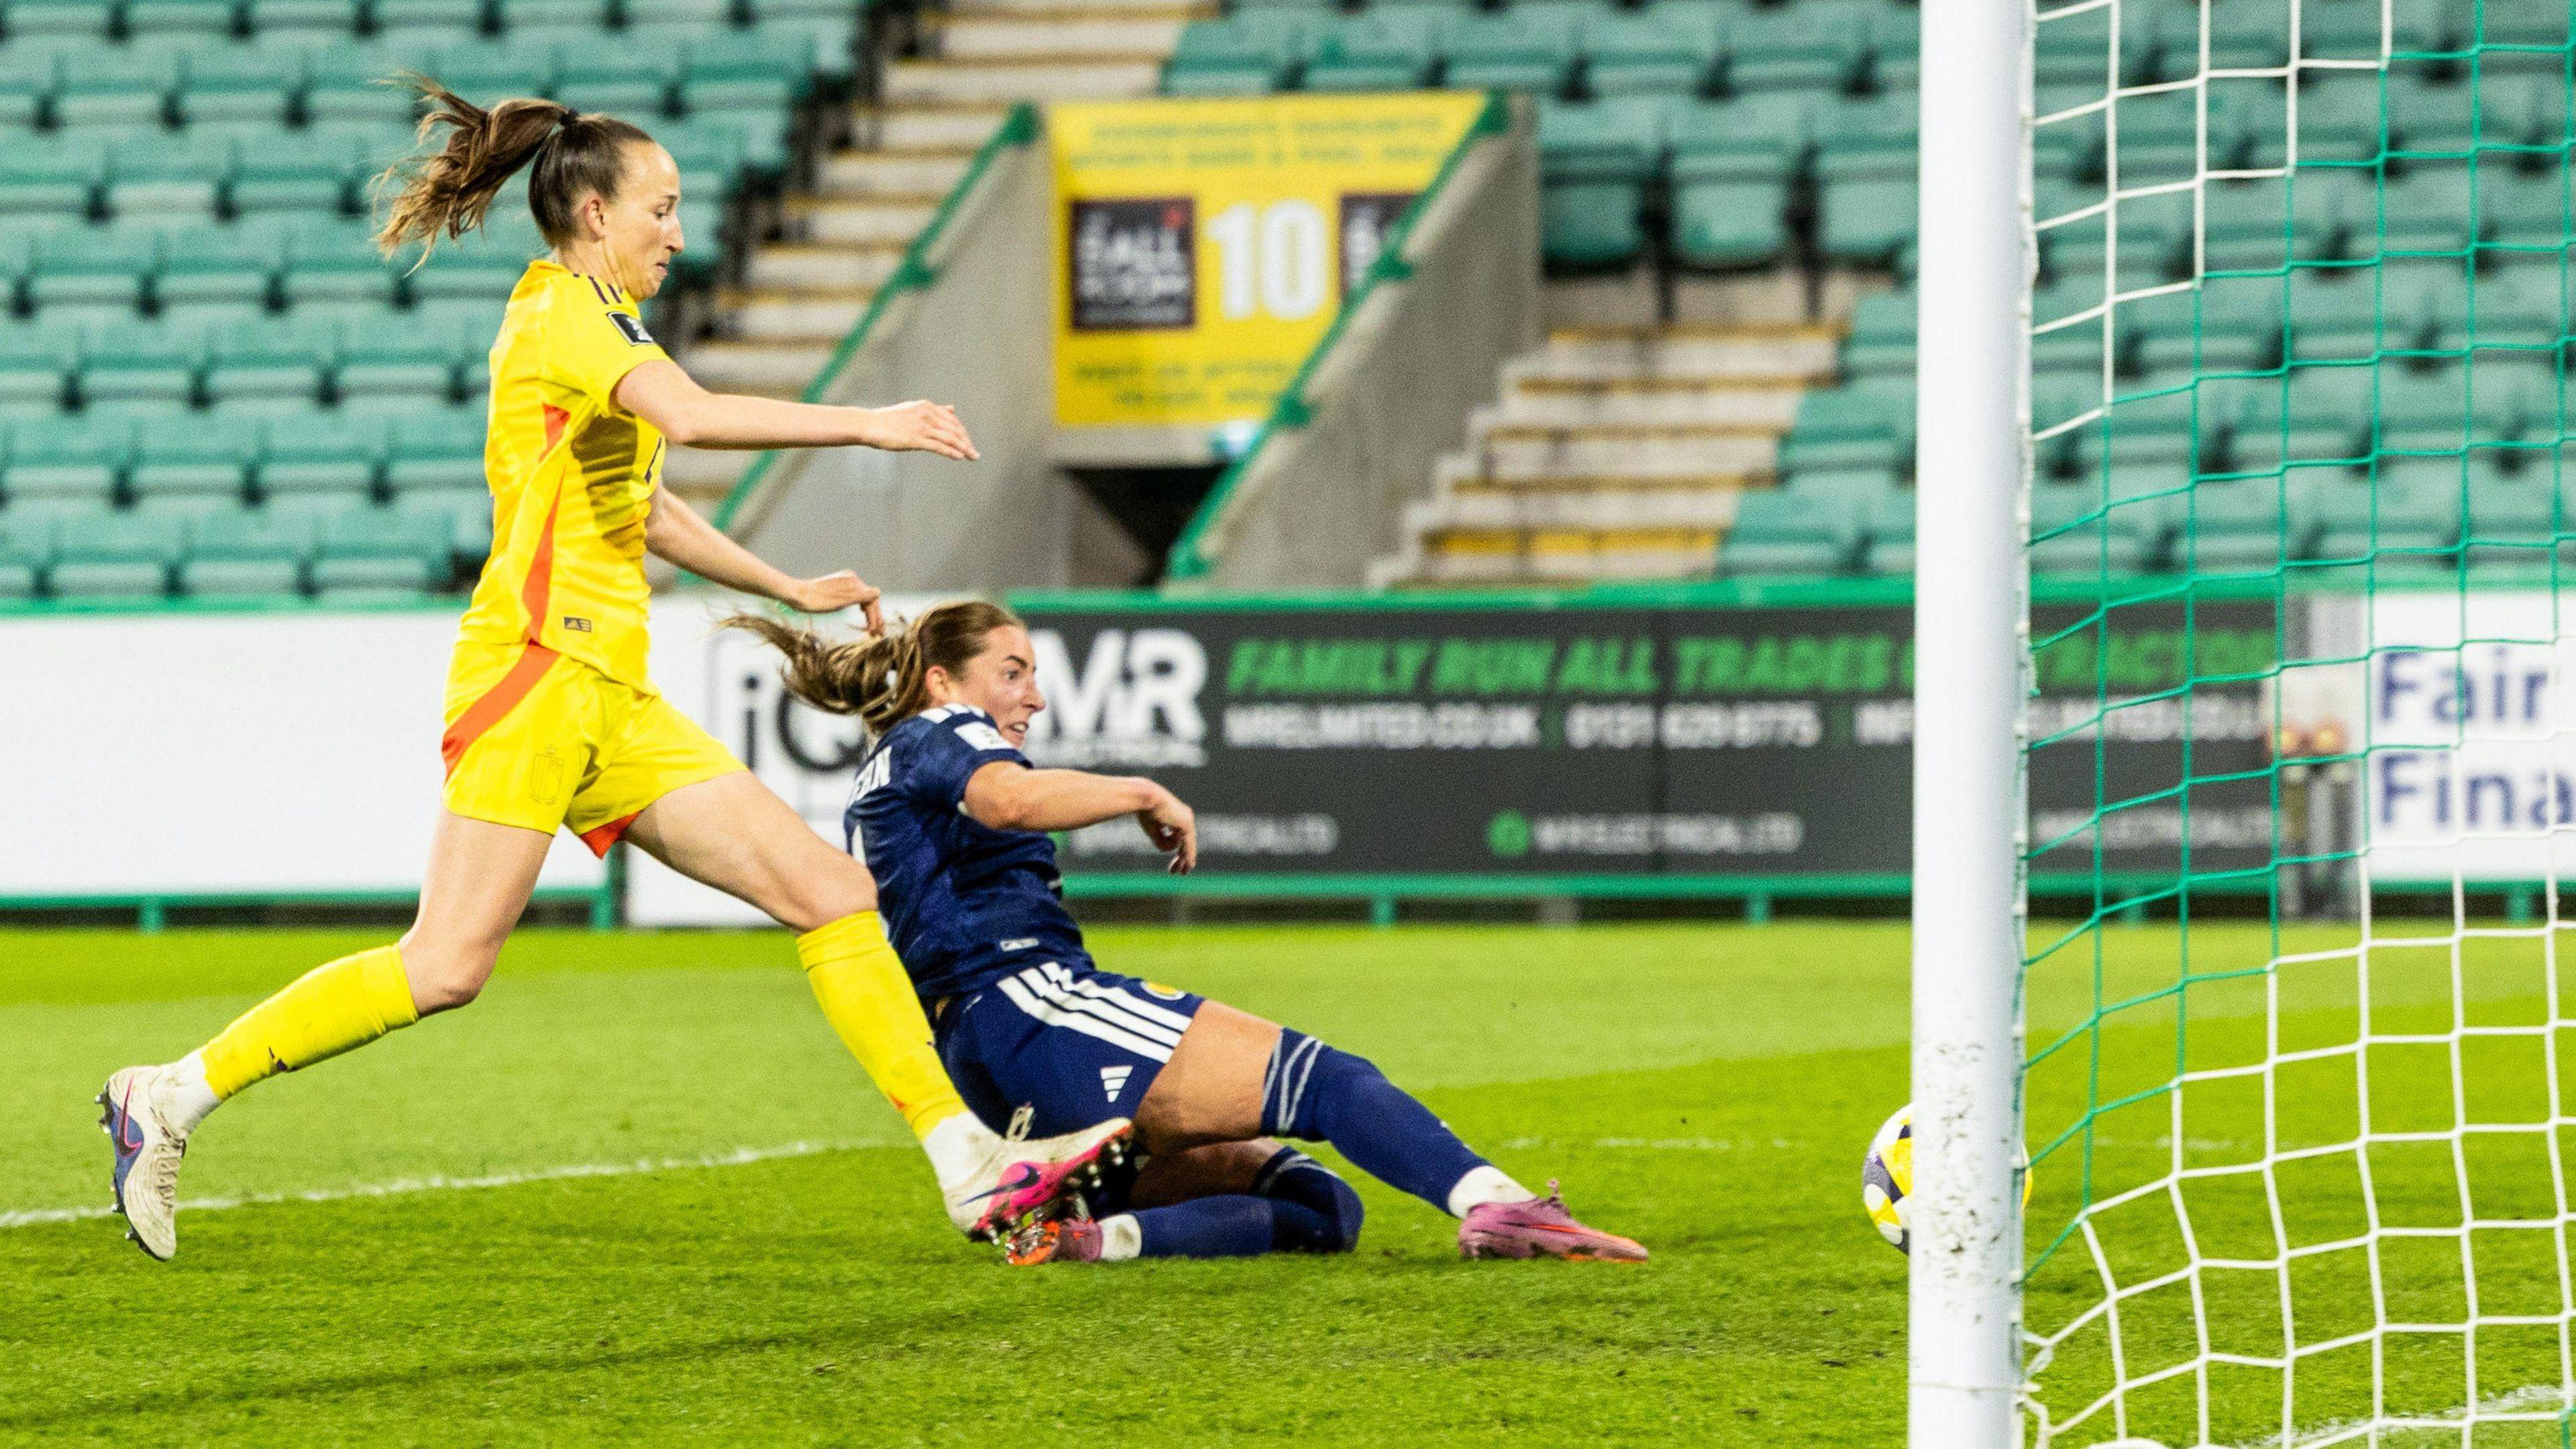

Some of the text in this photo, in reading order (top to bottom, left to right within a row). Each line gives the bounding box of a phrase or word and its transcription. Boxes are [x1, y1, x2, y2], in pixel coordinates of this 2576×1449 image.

[1208, 201, 1326, 320] 10
[1226, 637, 1431, 694] FAMILY
[1430, 637, 1556, 694] RUN
[1556, 636, 1660, 693] ALL
[1674, 635, 1892, 692] TRADES
[2381, 645, 2548, 723] Fair
[2380, 752, 2576, 827] Fina
